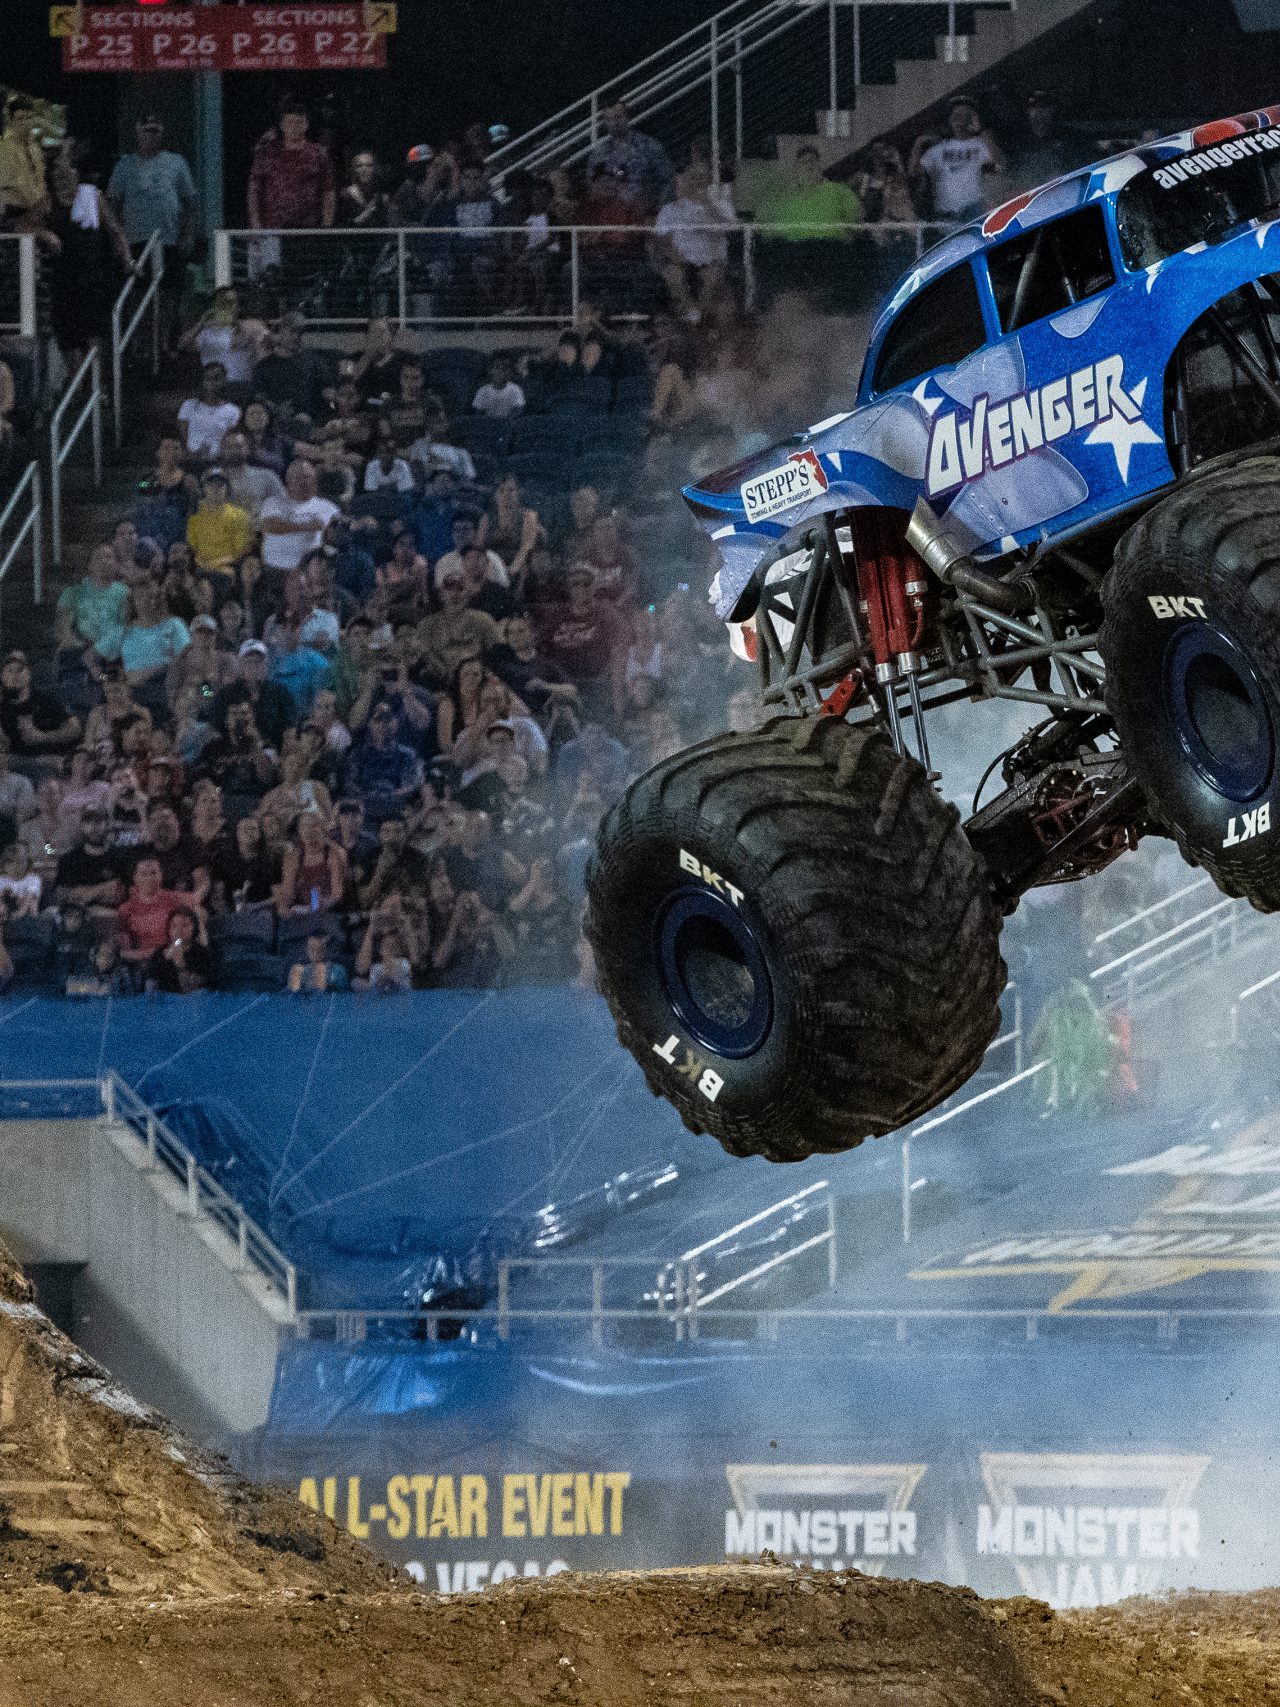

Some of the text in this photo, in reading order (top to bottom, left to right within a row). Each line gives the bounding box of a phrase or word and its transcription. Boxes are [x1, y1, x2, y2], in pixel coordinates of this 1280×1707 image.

[89, 11, 195, 28] SECTIONS
[252, 9, 356, 27] SECTIONS
[69, 34, 135, 55] P 25
[152, 33, 217, 55] P 26
[232, 32, 297, 54] P 26
[314, 31, 377, 53] P 27
[928, 354, 1142, 495] AVENGER
[745, 464, 810, 509] STEPP'S
[1147, 596, 1208, 619] BKT
[1222, 801, 1271, 848] BKT
[680, 849, 745, 907] BKT
[652, 1035, 725, 1102] BKT
[502, 1472, 631, 1537] EVENT
[725, 1510, 916, 1555] MONSTER
[977, 1505, 1200, 1557] MONSTER
